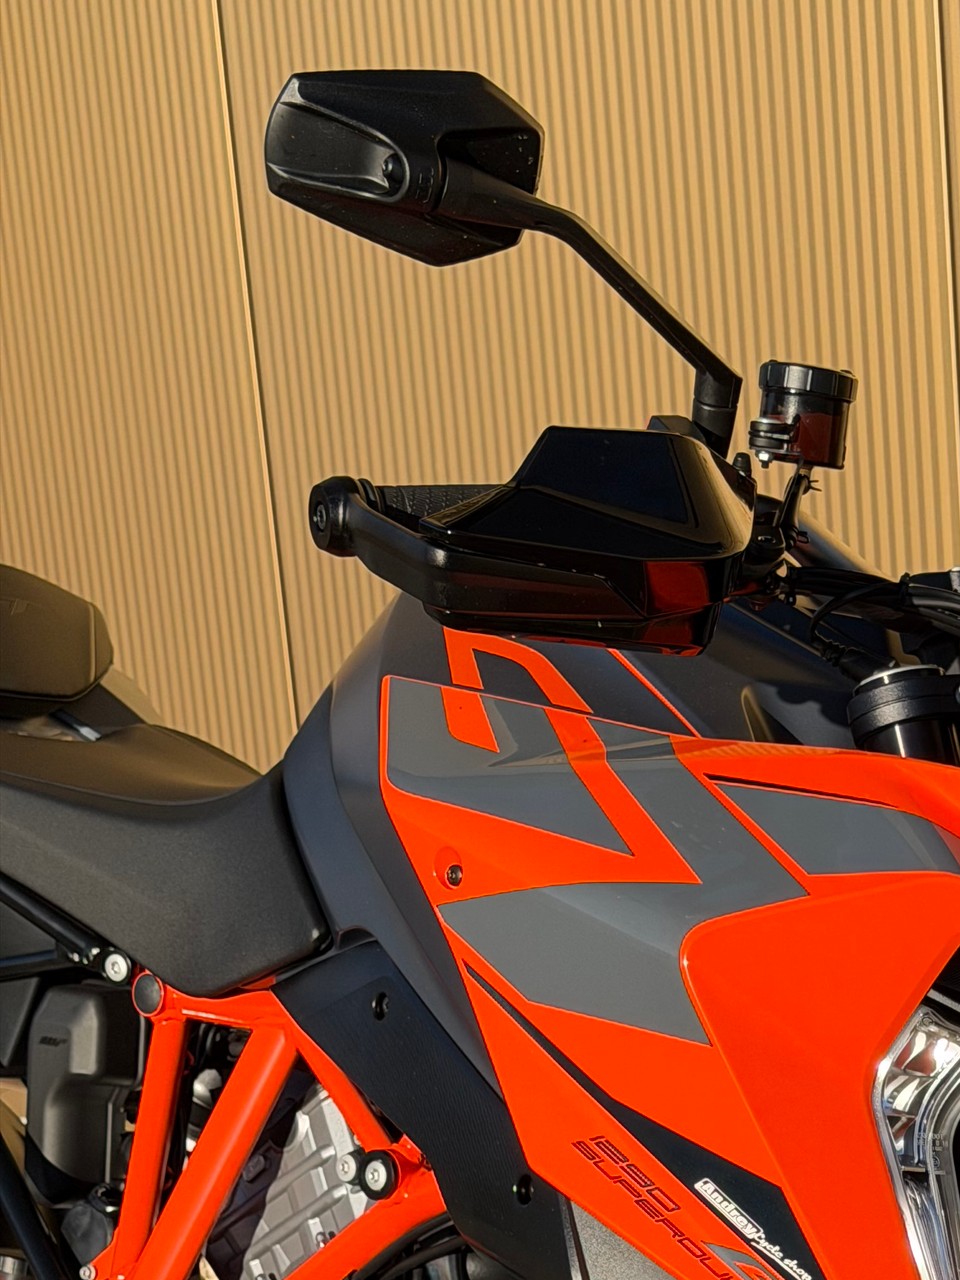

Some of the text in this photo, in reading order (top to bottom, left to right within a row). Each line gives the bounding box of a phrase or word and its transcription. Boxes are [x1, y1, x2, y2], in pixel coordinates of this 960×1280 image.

[589, 1136, 681, 1213] 1290
[699, 1180, 760, 1238] Andrey
[754, 1231, 784, 1259] Cycle
